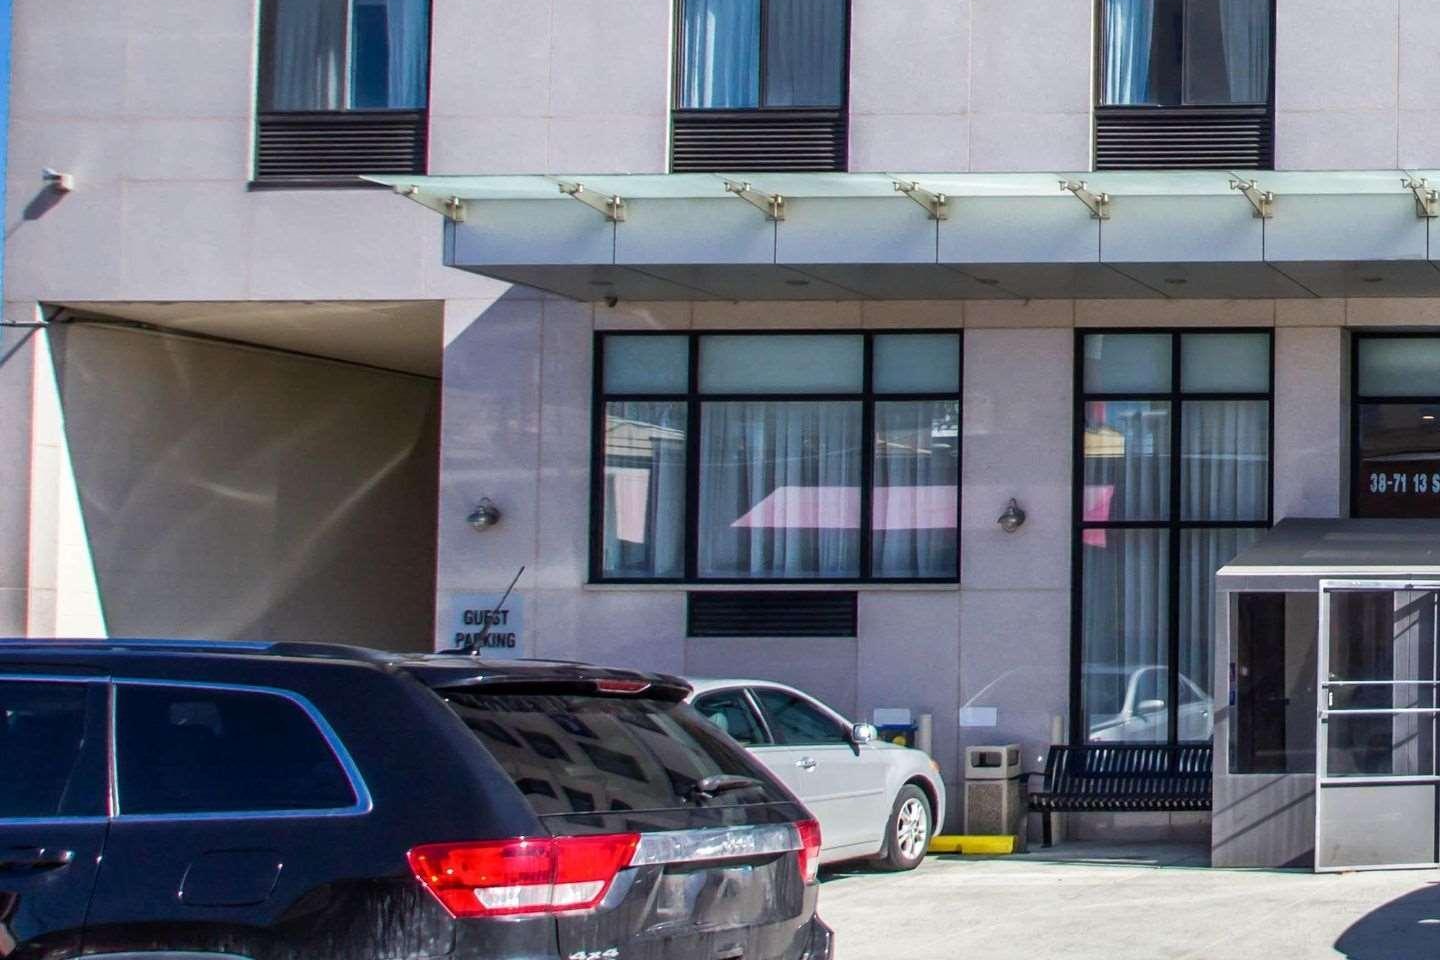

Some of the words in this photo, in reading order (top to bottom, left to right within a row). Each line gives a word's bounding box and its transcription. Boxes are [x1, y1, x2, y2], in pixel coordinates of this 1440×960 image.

[1369, 472, 1407, 493] 38-71
[1413, 473, 1428, 493] 13
[463, 609, 510, 625] GUEST
